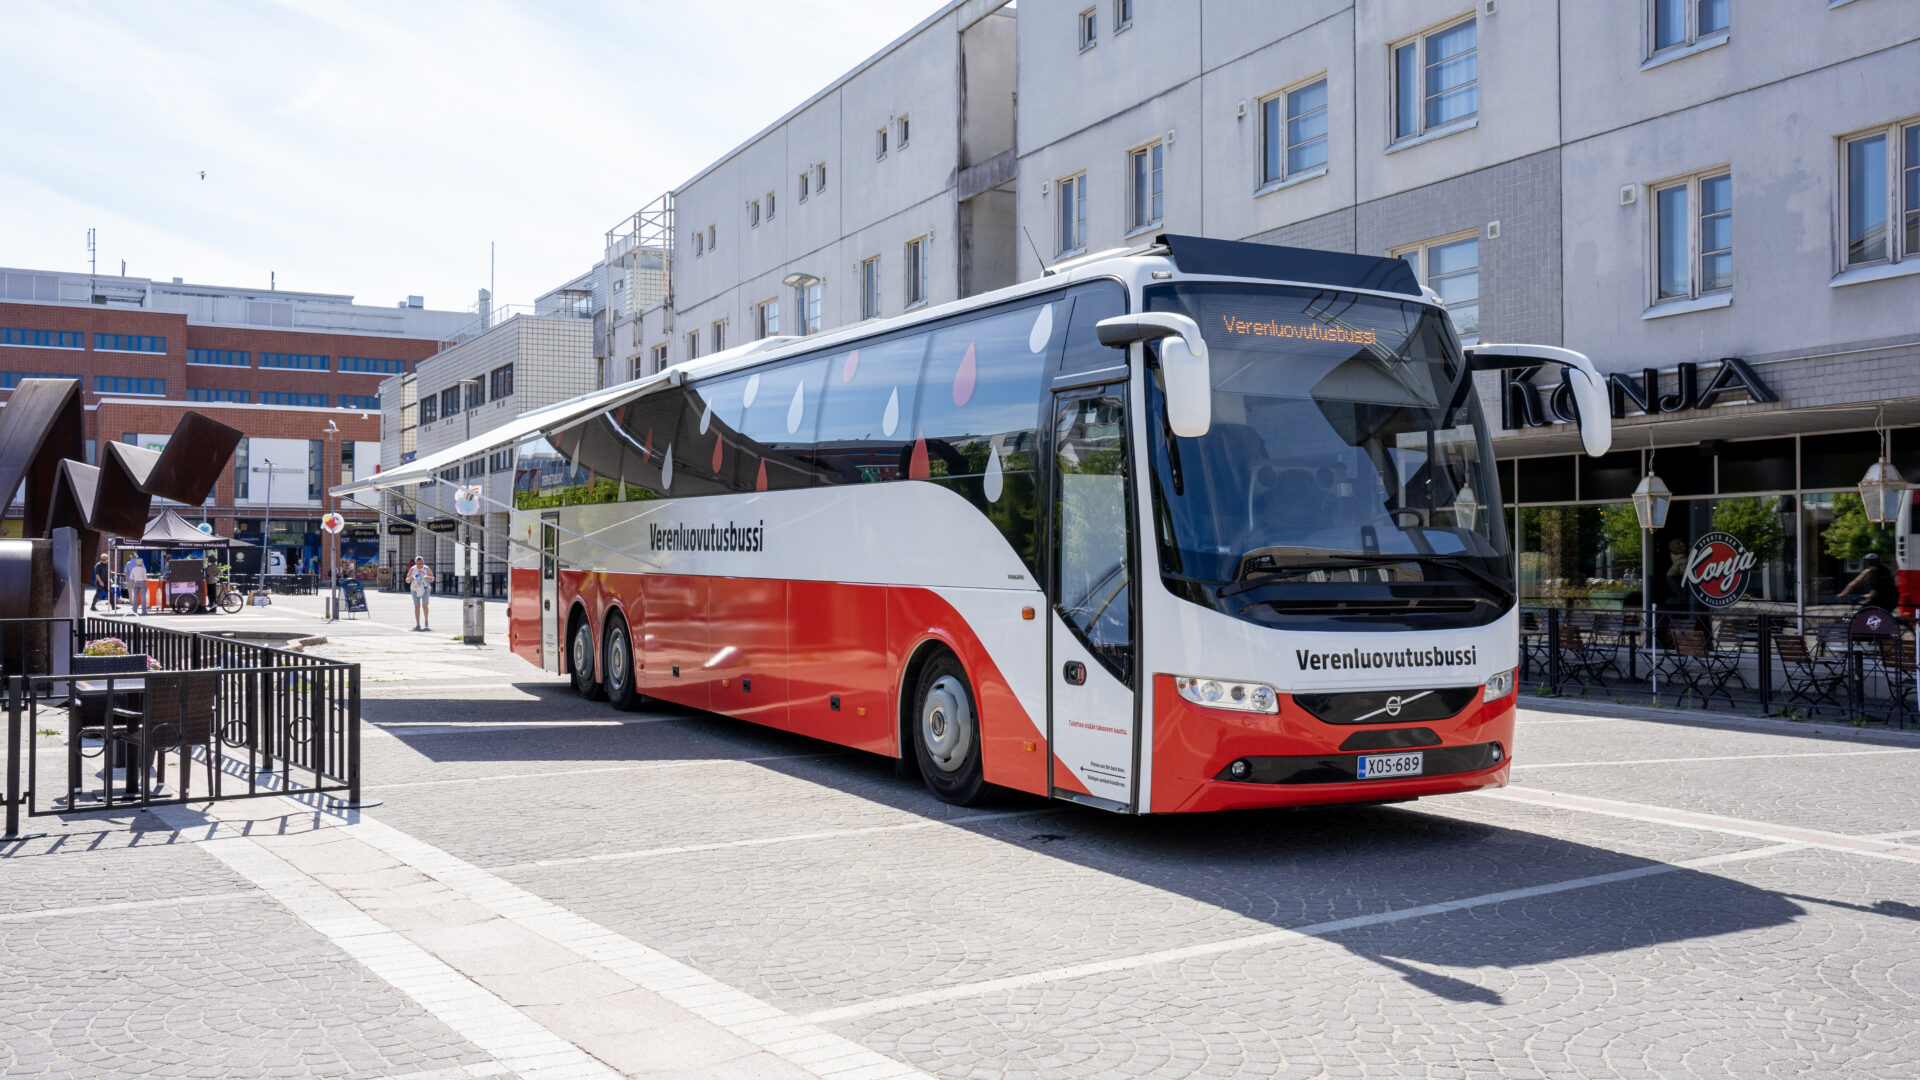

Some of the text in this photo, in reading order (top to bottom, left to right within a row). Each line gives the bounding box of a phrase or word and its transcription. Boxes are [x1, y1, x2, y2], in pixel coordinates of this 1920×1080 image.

[1223, 314, 1376, 344] Verenluovutusbussi
[649, 519, 763, 552] Verenluovutusbussi
[1681, 546, 1757, 591] Konja
[1296, 645, 1477, 671] Verenluovutusbussi
[1368, 756, 1420, 775] XOS-689
